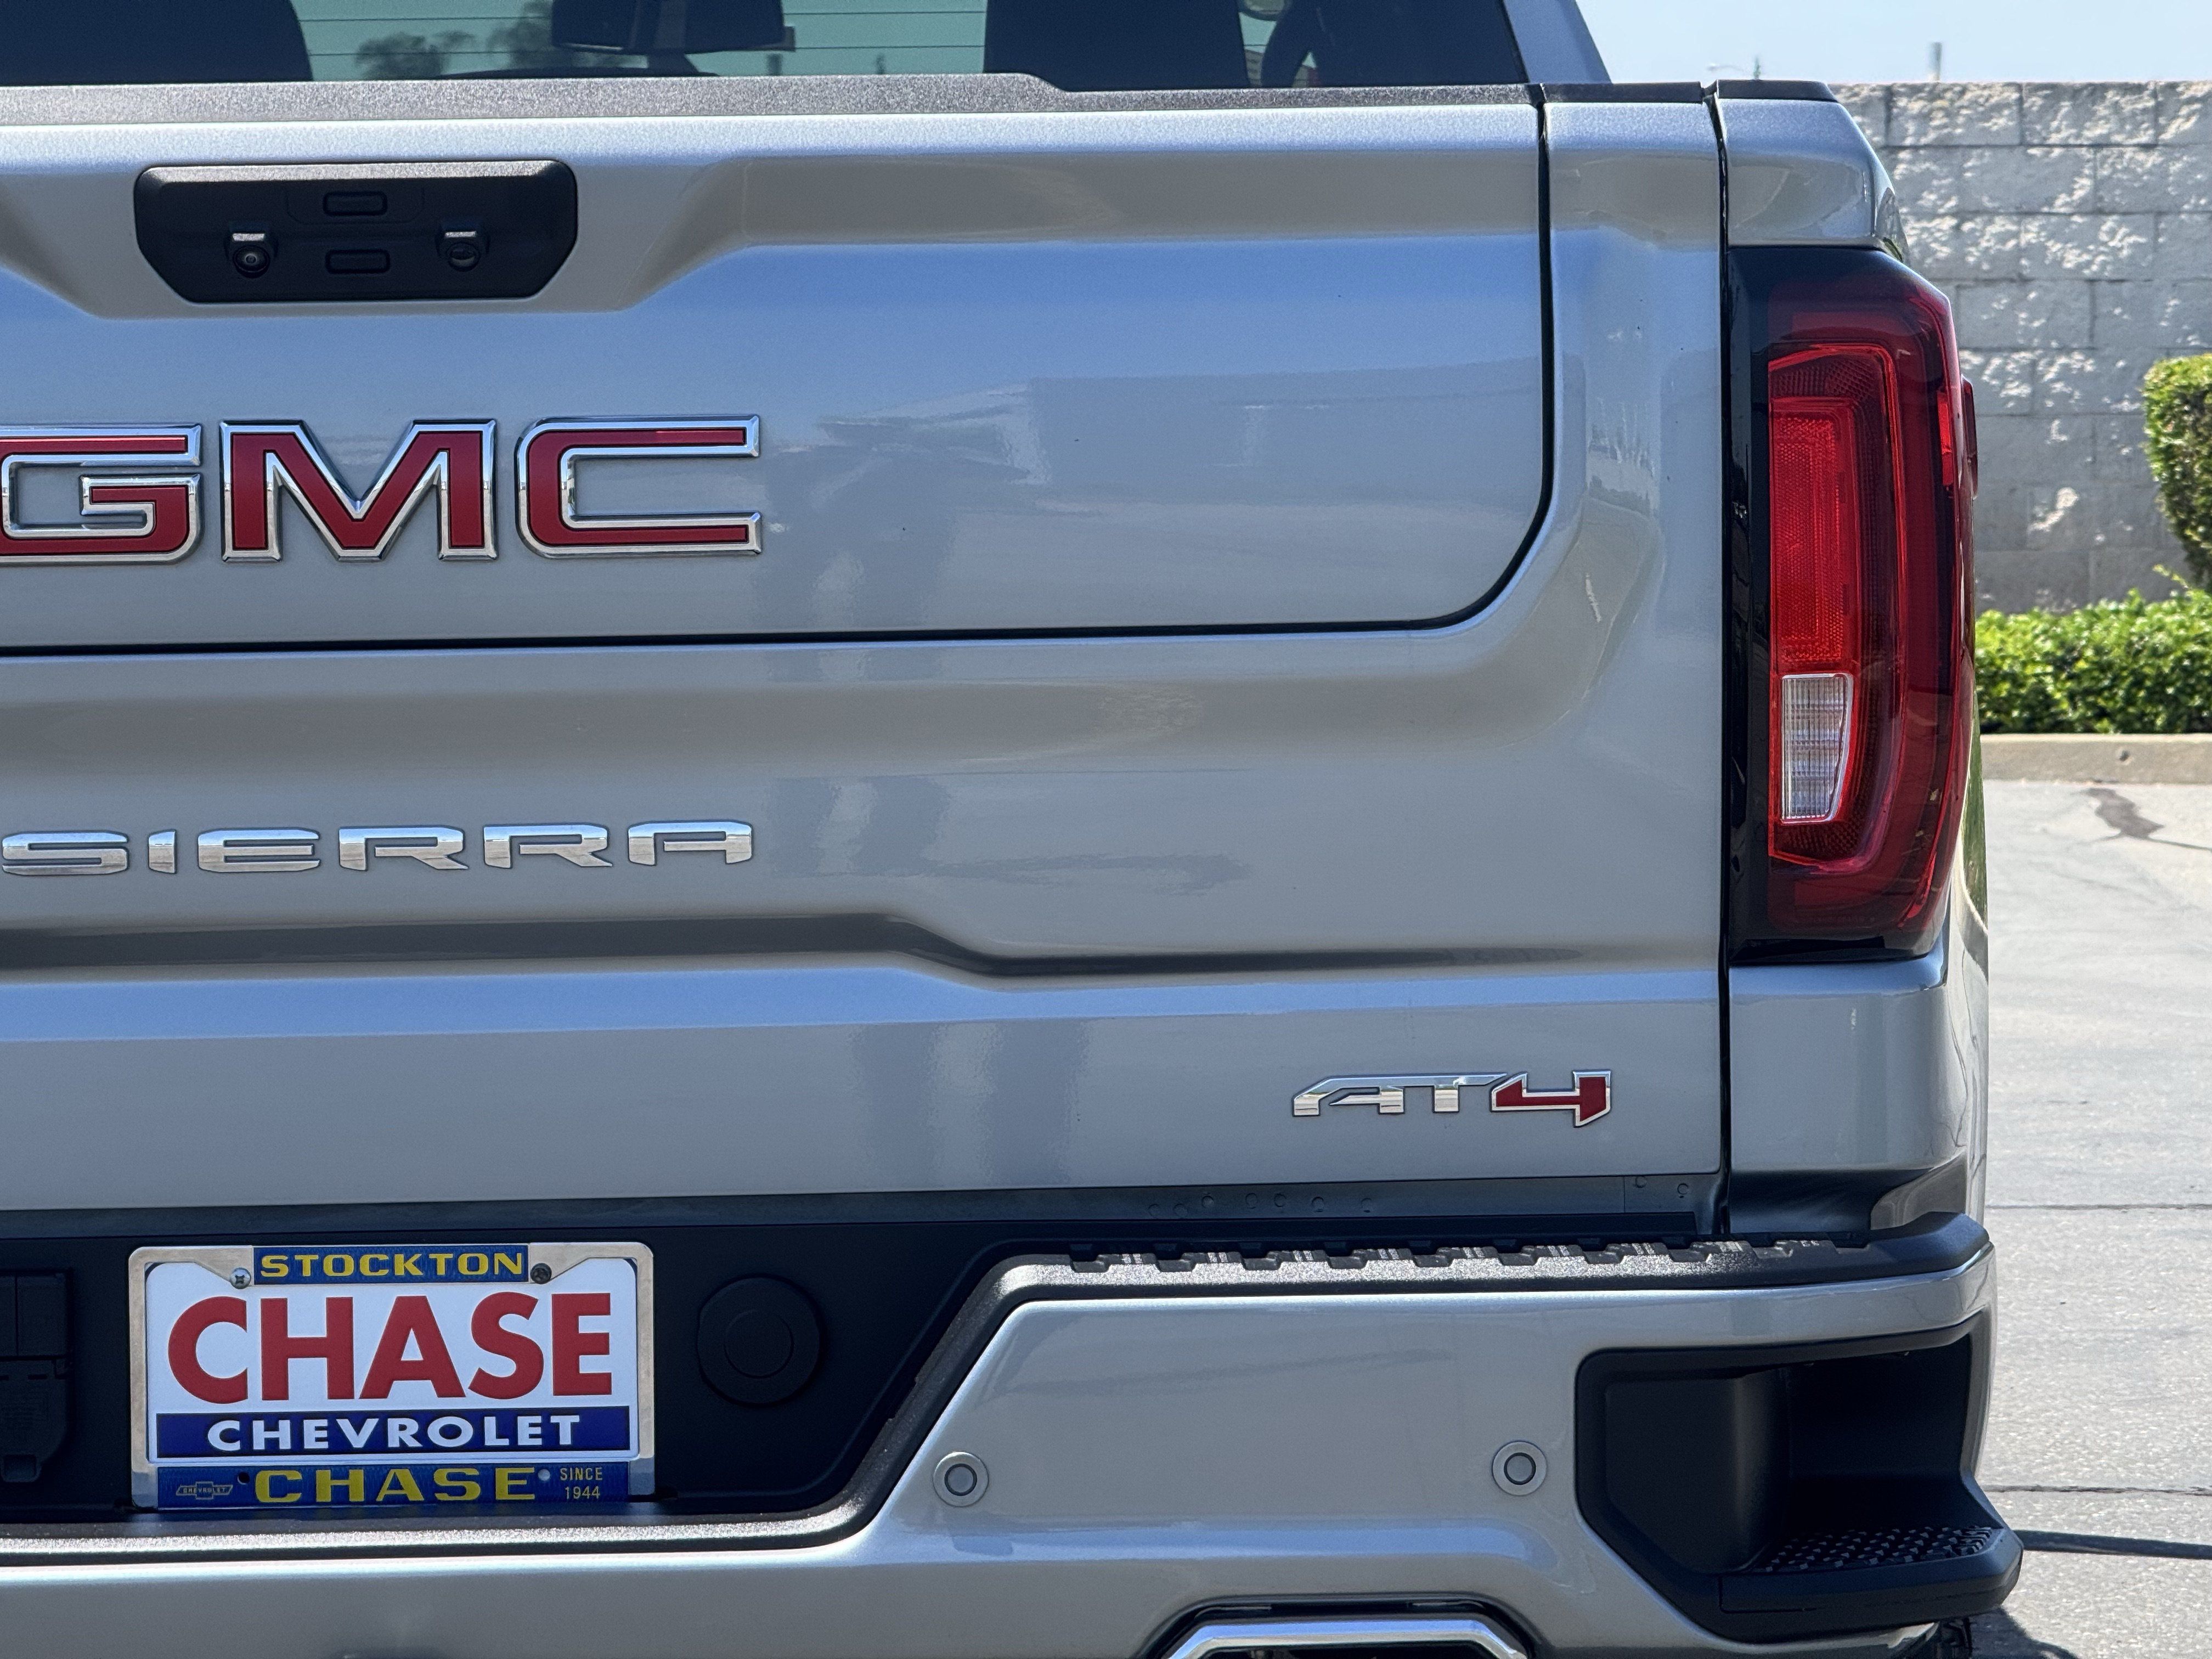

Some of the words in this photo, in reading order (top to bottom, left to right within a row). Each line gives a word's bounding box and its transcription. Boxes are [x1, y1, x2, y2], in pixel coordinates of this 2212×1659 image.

[0, 415, 761, 564] GMC
[1, 821, 754, 876] SIERRA
[1293, 1070, 1612, 1128] AT4
[261, 1252, 522, 1278] STOCKTON
[167, 1291, 612, 1404] CHASE
[207, 1415, 580, 1452] CHEVROLET
[255, 1467, 536, 1504] CHASE
[560, 1467, 603, 1482] SINCE
[565, 1485, 601, 1500] 1944
